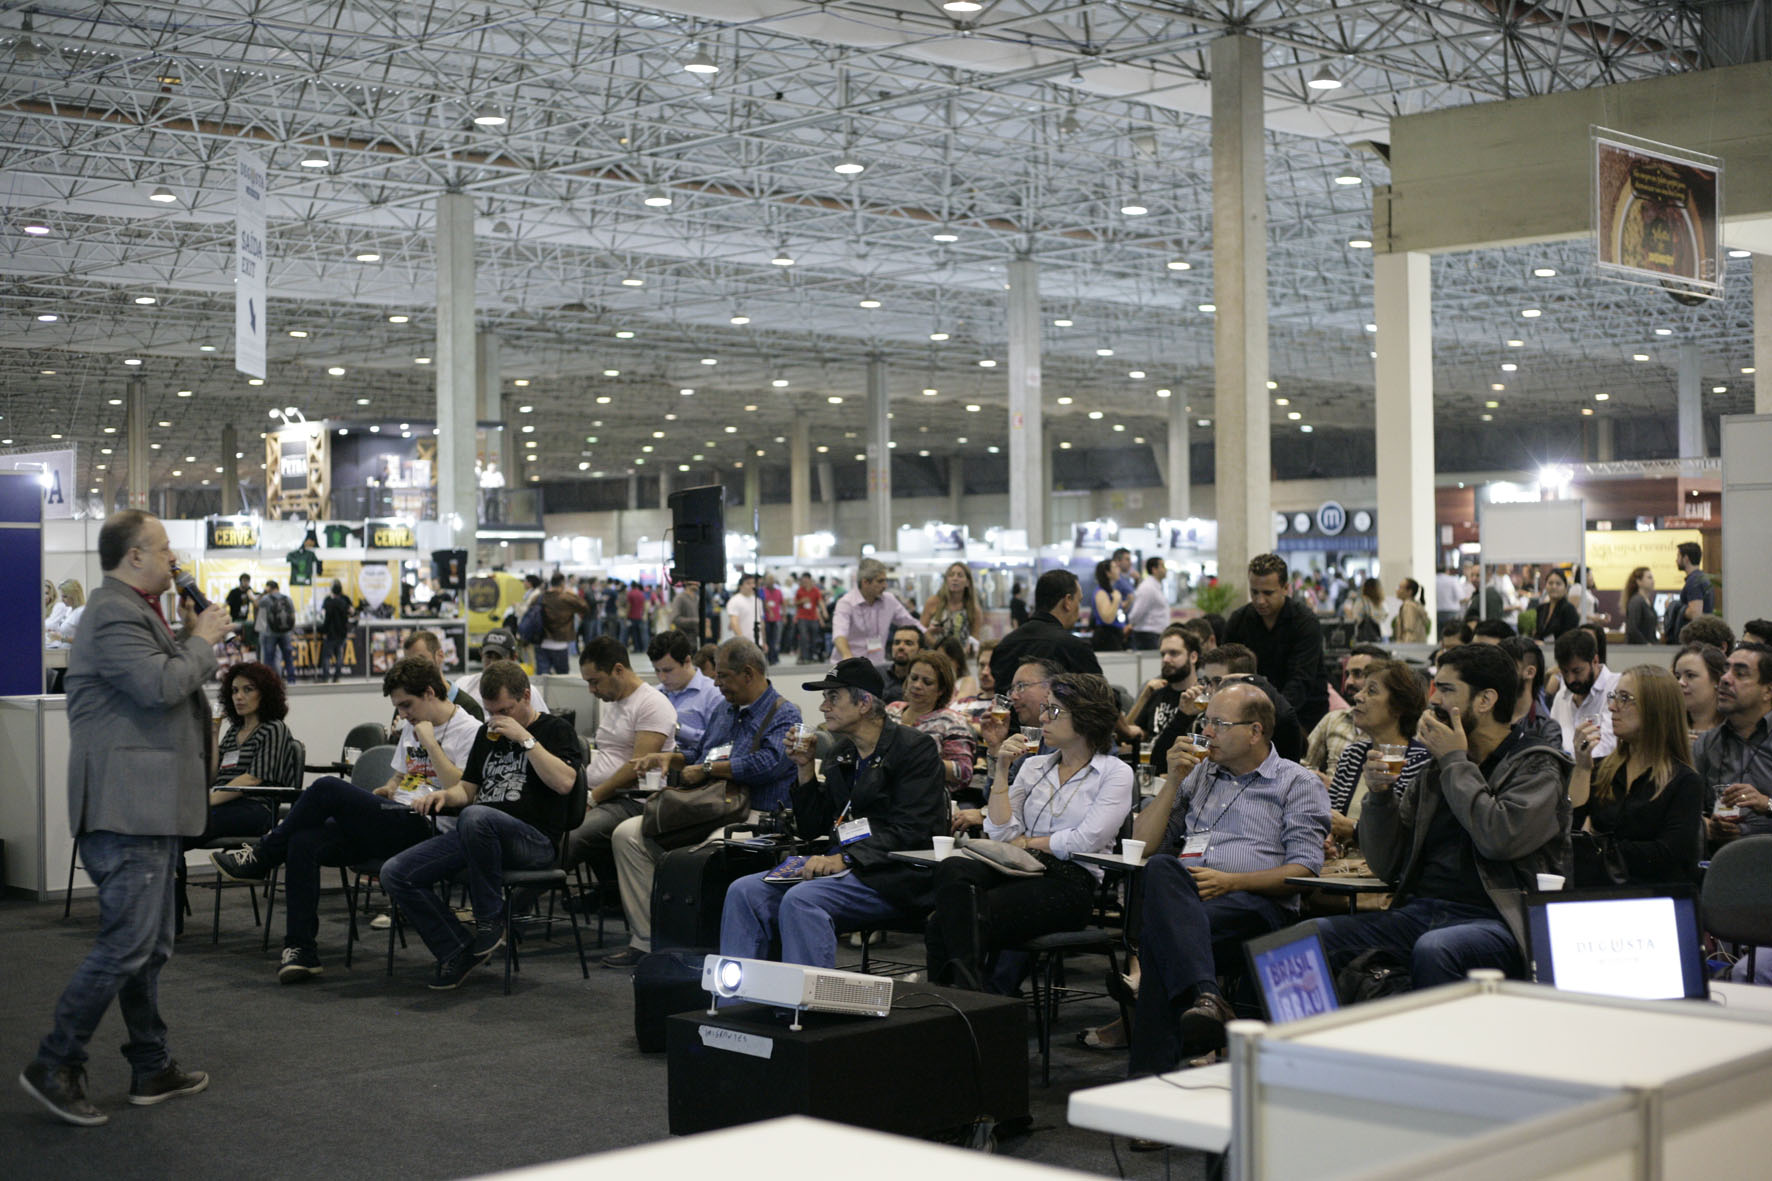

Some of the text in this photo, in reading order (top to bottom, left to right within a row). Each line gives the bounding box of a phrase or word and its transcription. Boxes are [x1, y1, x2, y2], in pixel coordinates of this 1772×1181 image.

[241, 230, 263, 261] SAÍDA
[241, 256, 257, 279] EXIT
[1270, 952, 1313, 987] BRASIL
